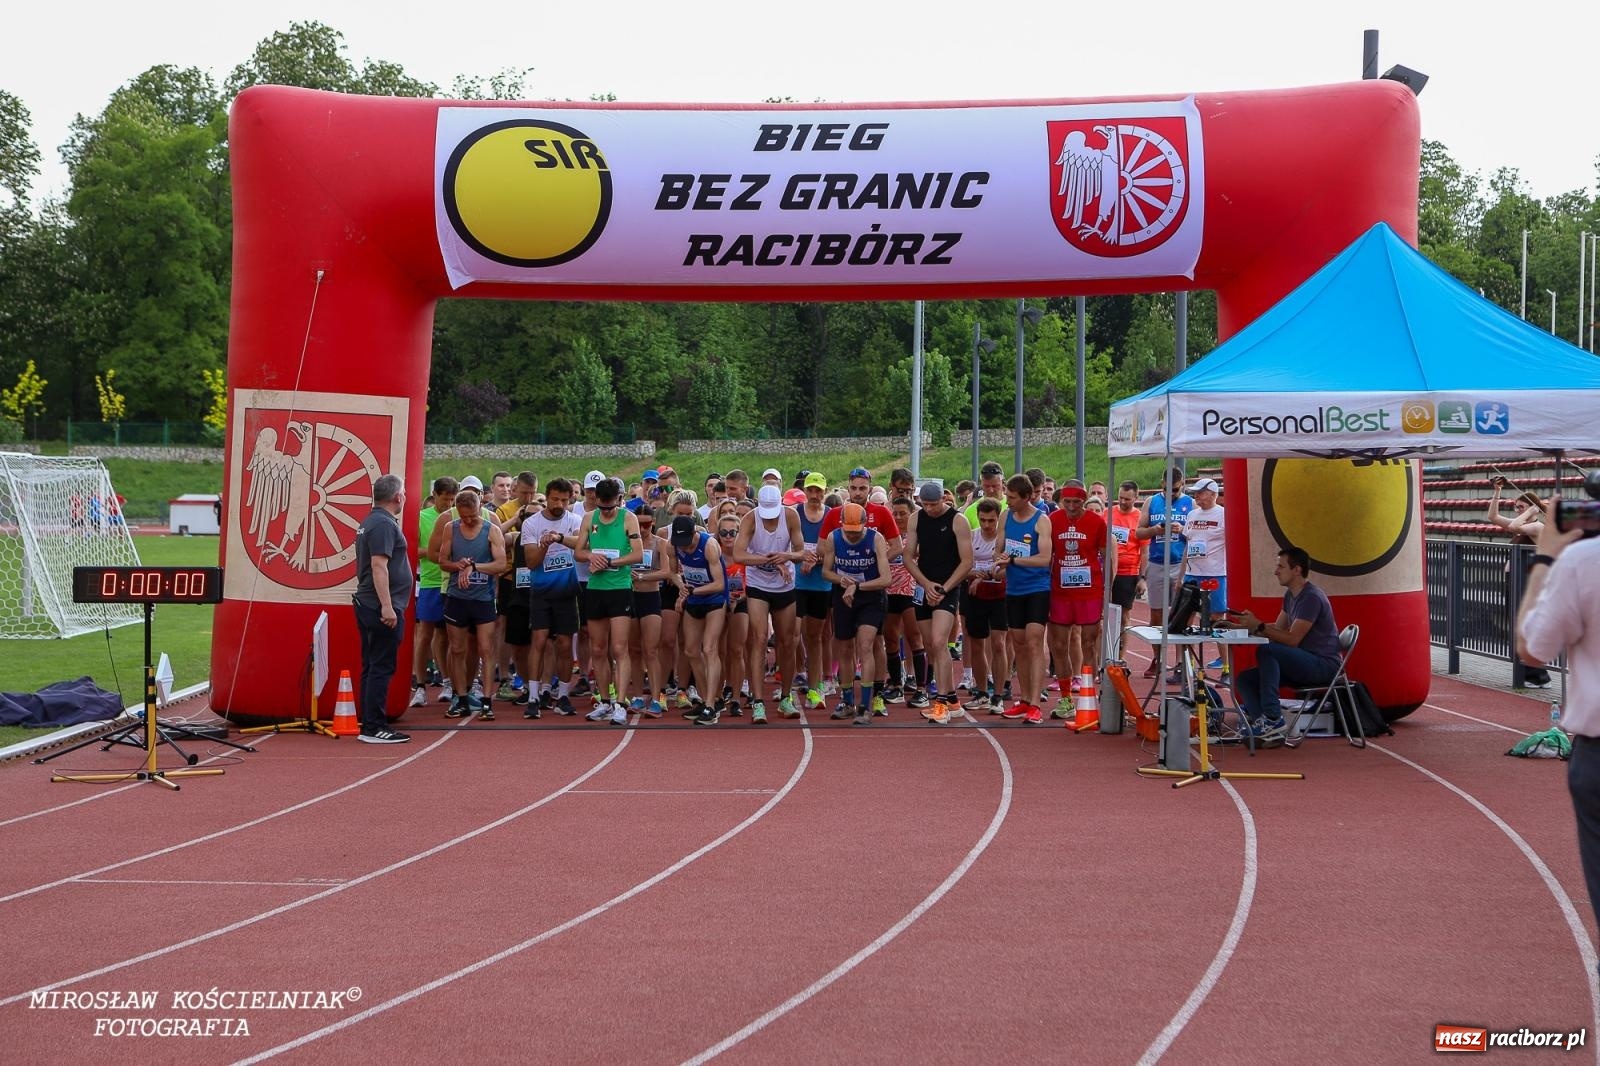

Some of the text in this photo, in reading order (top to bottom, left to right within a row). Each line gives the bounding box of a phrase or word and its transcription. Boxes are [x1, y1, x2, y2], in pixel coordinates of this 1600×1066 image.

[753, 123, 889, 151] BIEG
[524, 139, 608, 169] SIR
[654, 171, 990, 210] BEZ GRANIC
[683, 223, 963, 266] RACIBÓRZ
[1202, 406, 1391, 435] PersonalBest
[550, 556, 566, 566] 205
[835, 556, 875, 567] RUNNERS
[102, 573, 205, 596] 0:00:00
[1068, 574, 1084, 583] 168
